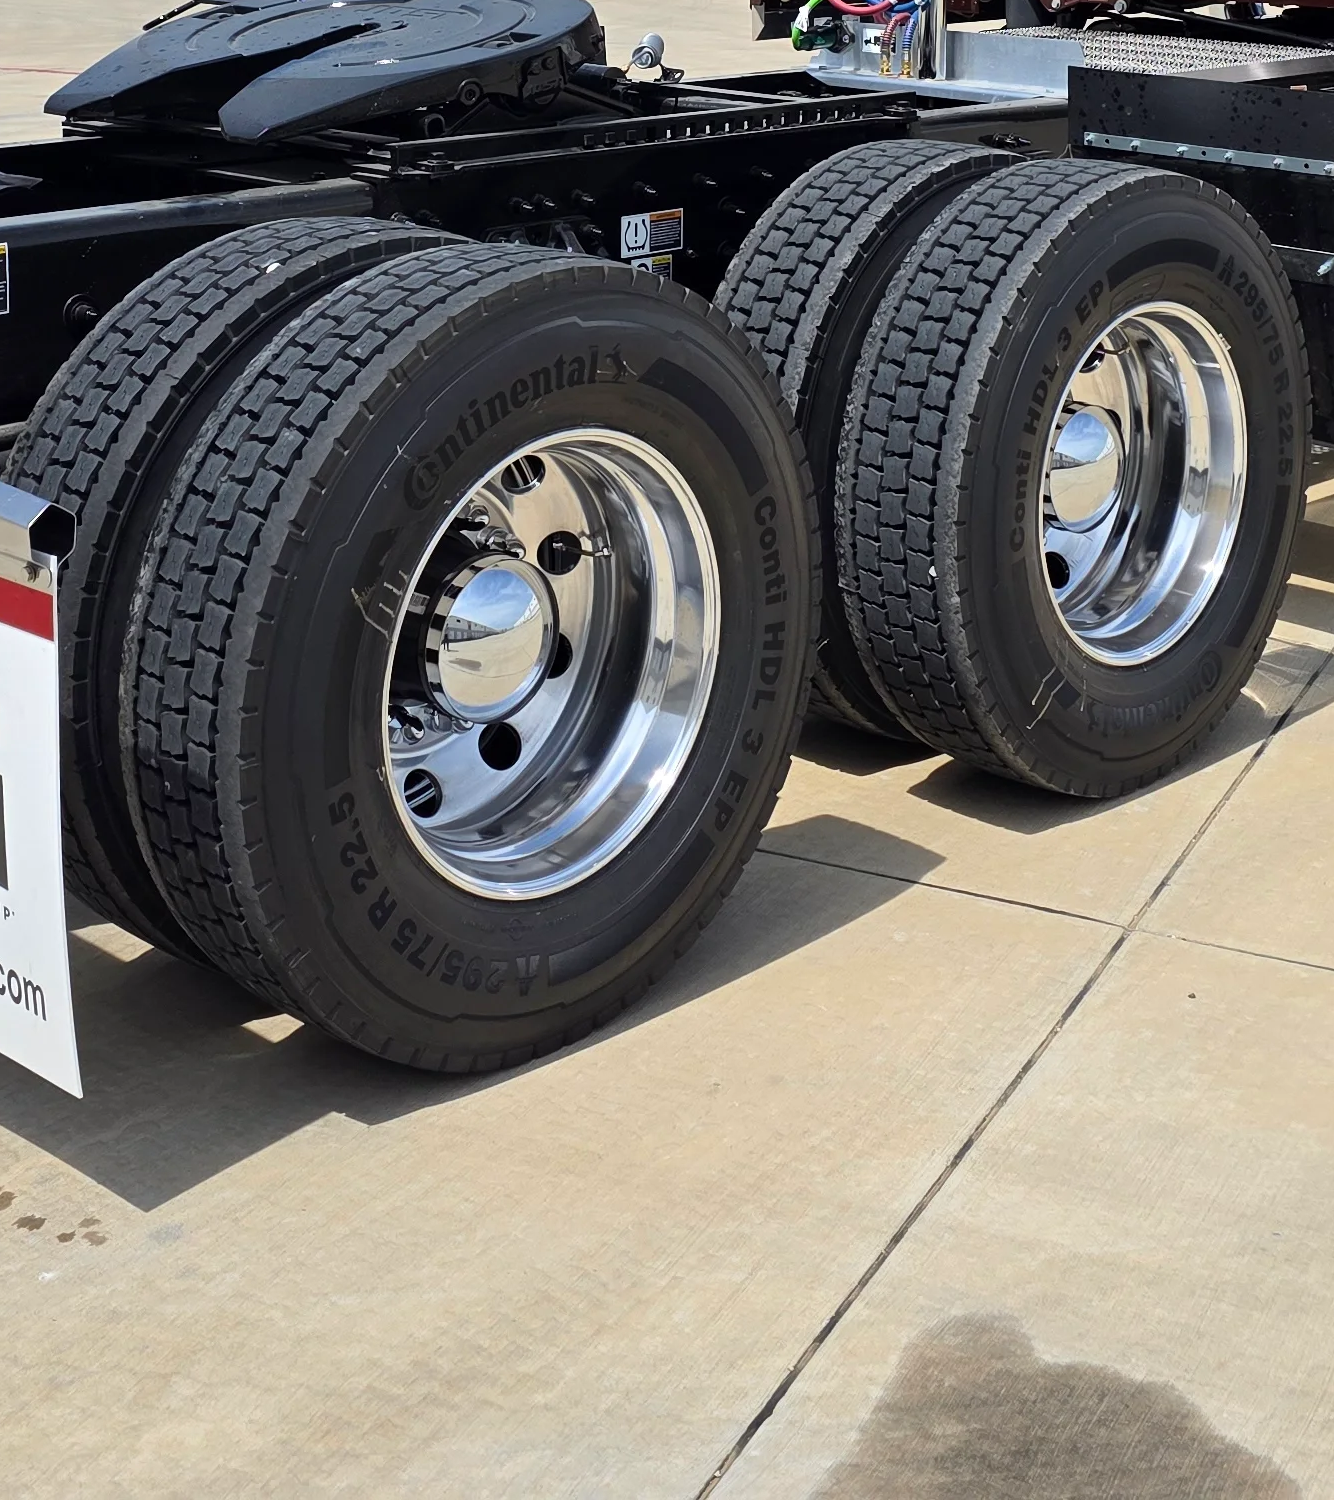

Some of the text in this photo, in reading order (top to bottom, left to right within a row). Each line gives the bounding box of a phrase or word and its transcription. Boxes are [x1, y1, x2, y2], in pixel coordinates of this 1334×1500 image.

[401, 343, 599, 512] Continental
[1009, 279, 1109, 554] Conti HDL 3 EP
[1232, 271, 1294, 479] 295/75 R 22.5
[711, 494, 788, 834] Conti HDL 3 EP
[328, 789, 510, 996] 295/75 R 22.5
